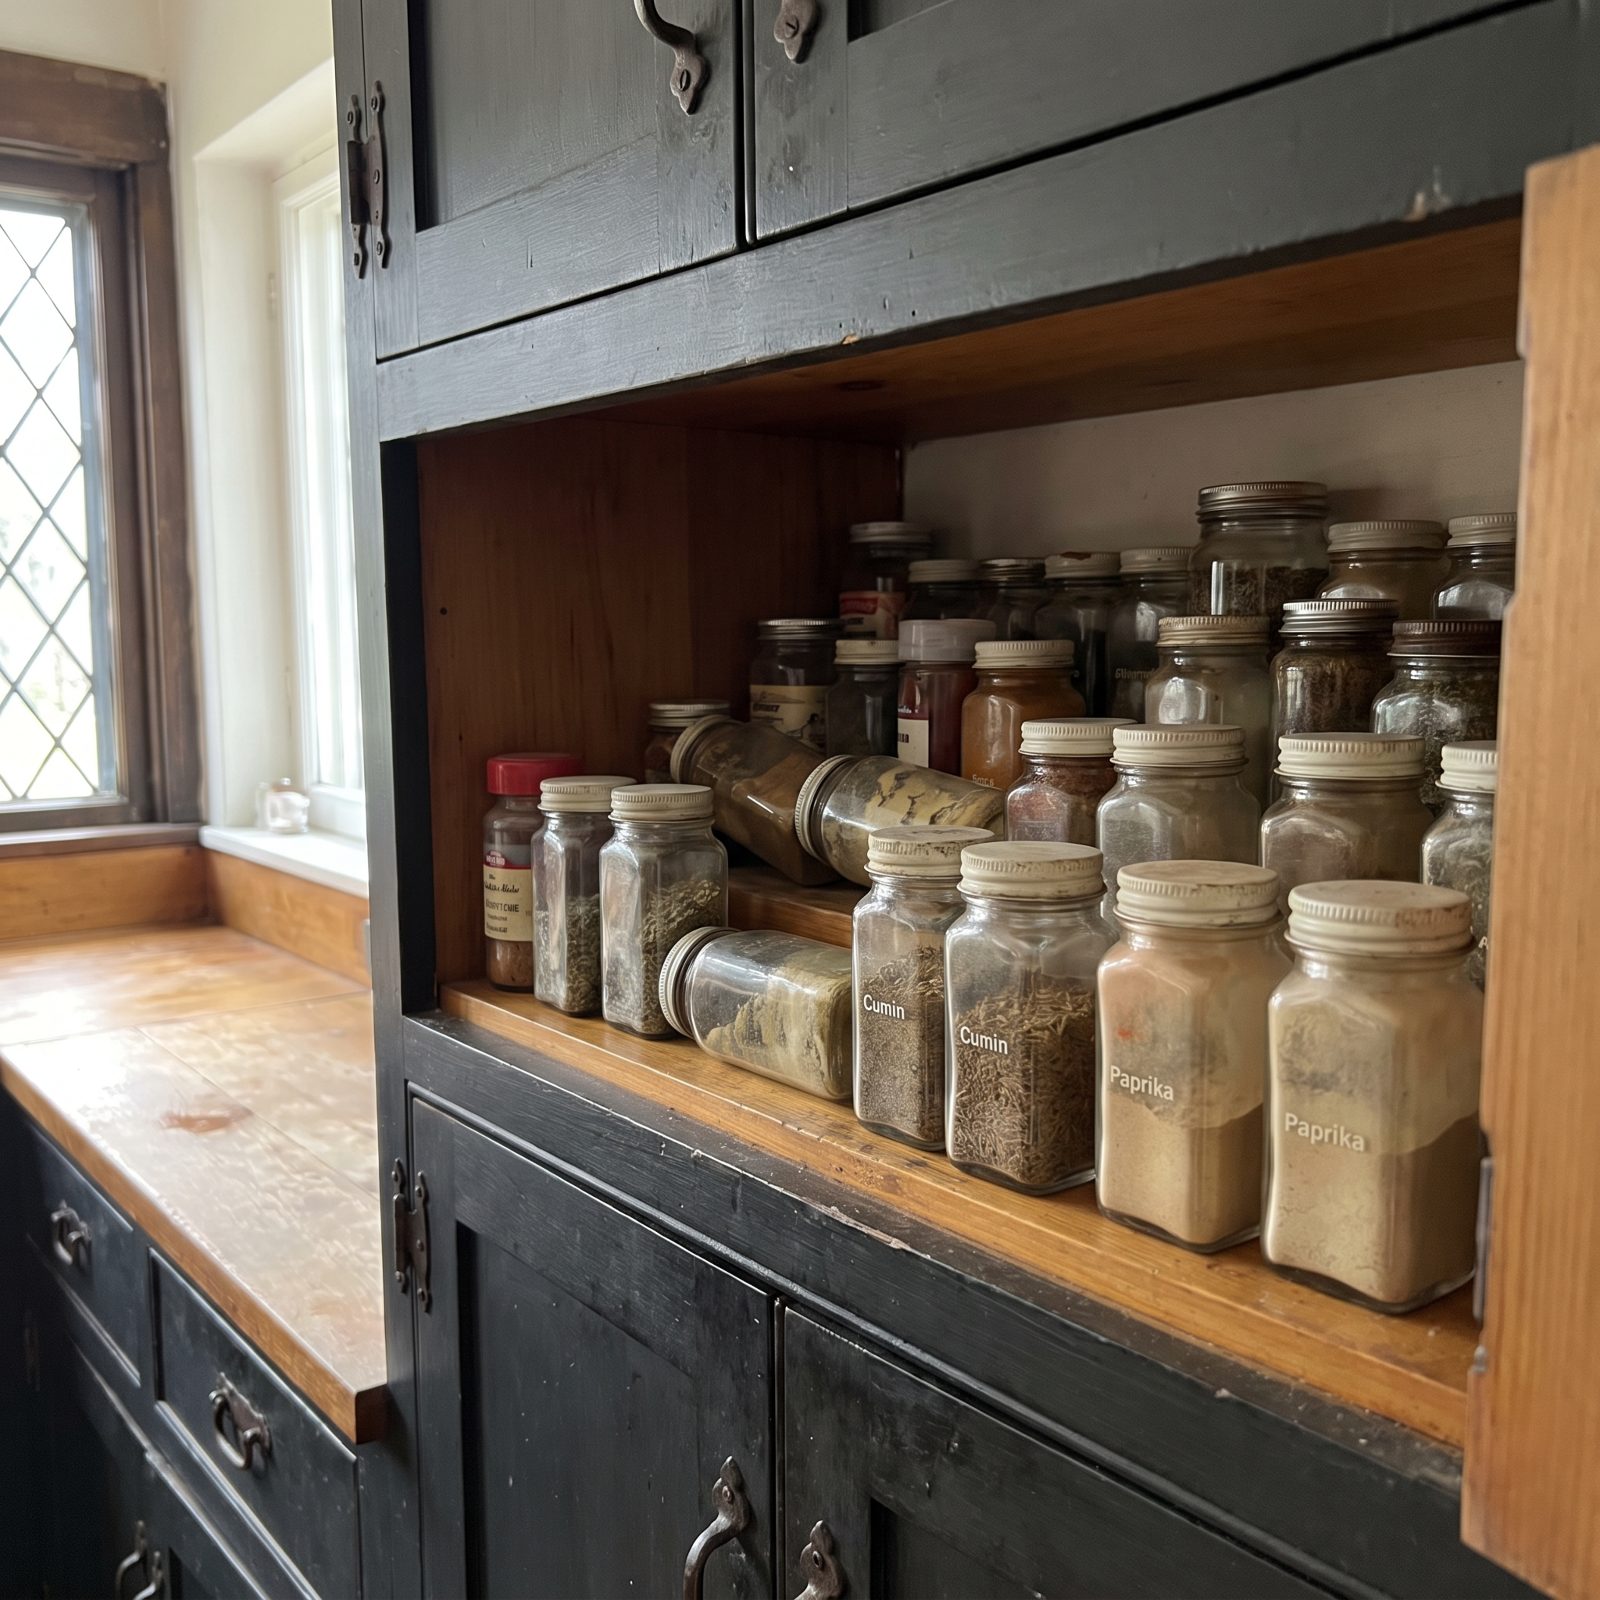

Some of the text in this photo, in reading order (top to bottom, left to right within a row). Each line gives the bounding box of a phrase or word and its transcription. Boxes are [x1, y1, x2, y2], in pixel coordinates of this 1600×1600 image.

[863, 994, 905, 1020] Cumin
[960, 1026, 1008, 1055] Cumin
[1110, 1064, 1174, 1102] Paprika
[1285, 1112, 1365, 1152] Paprika
